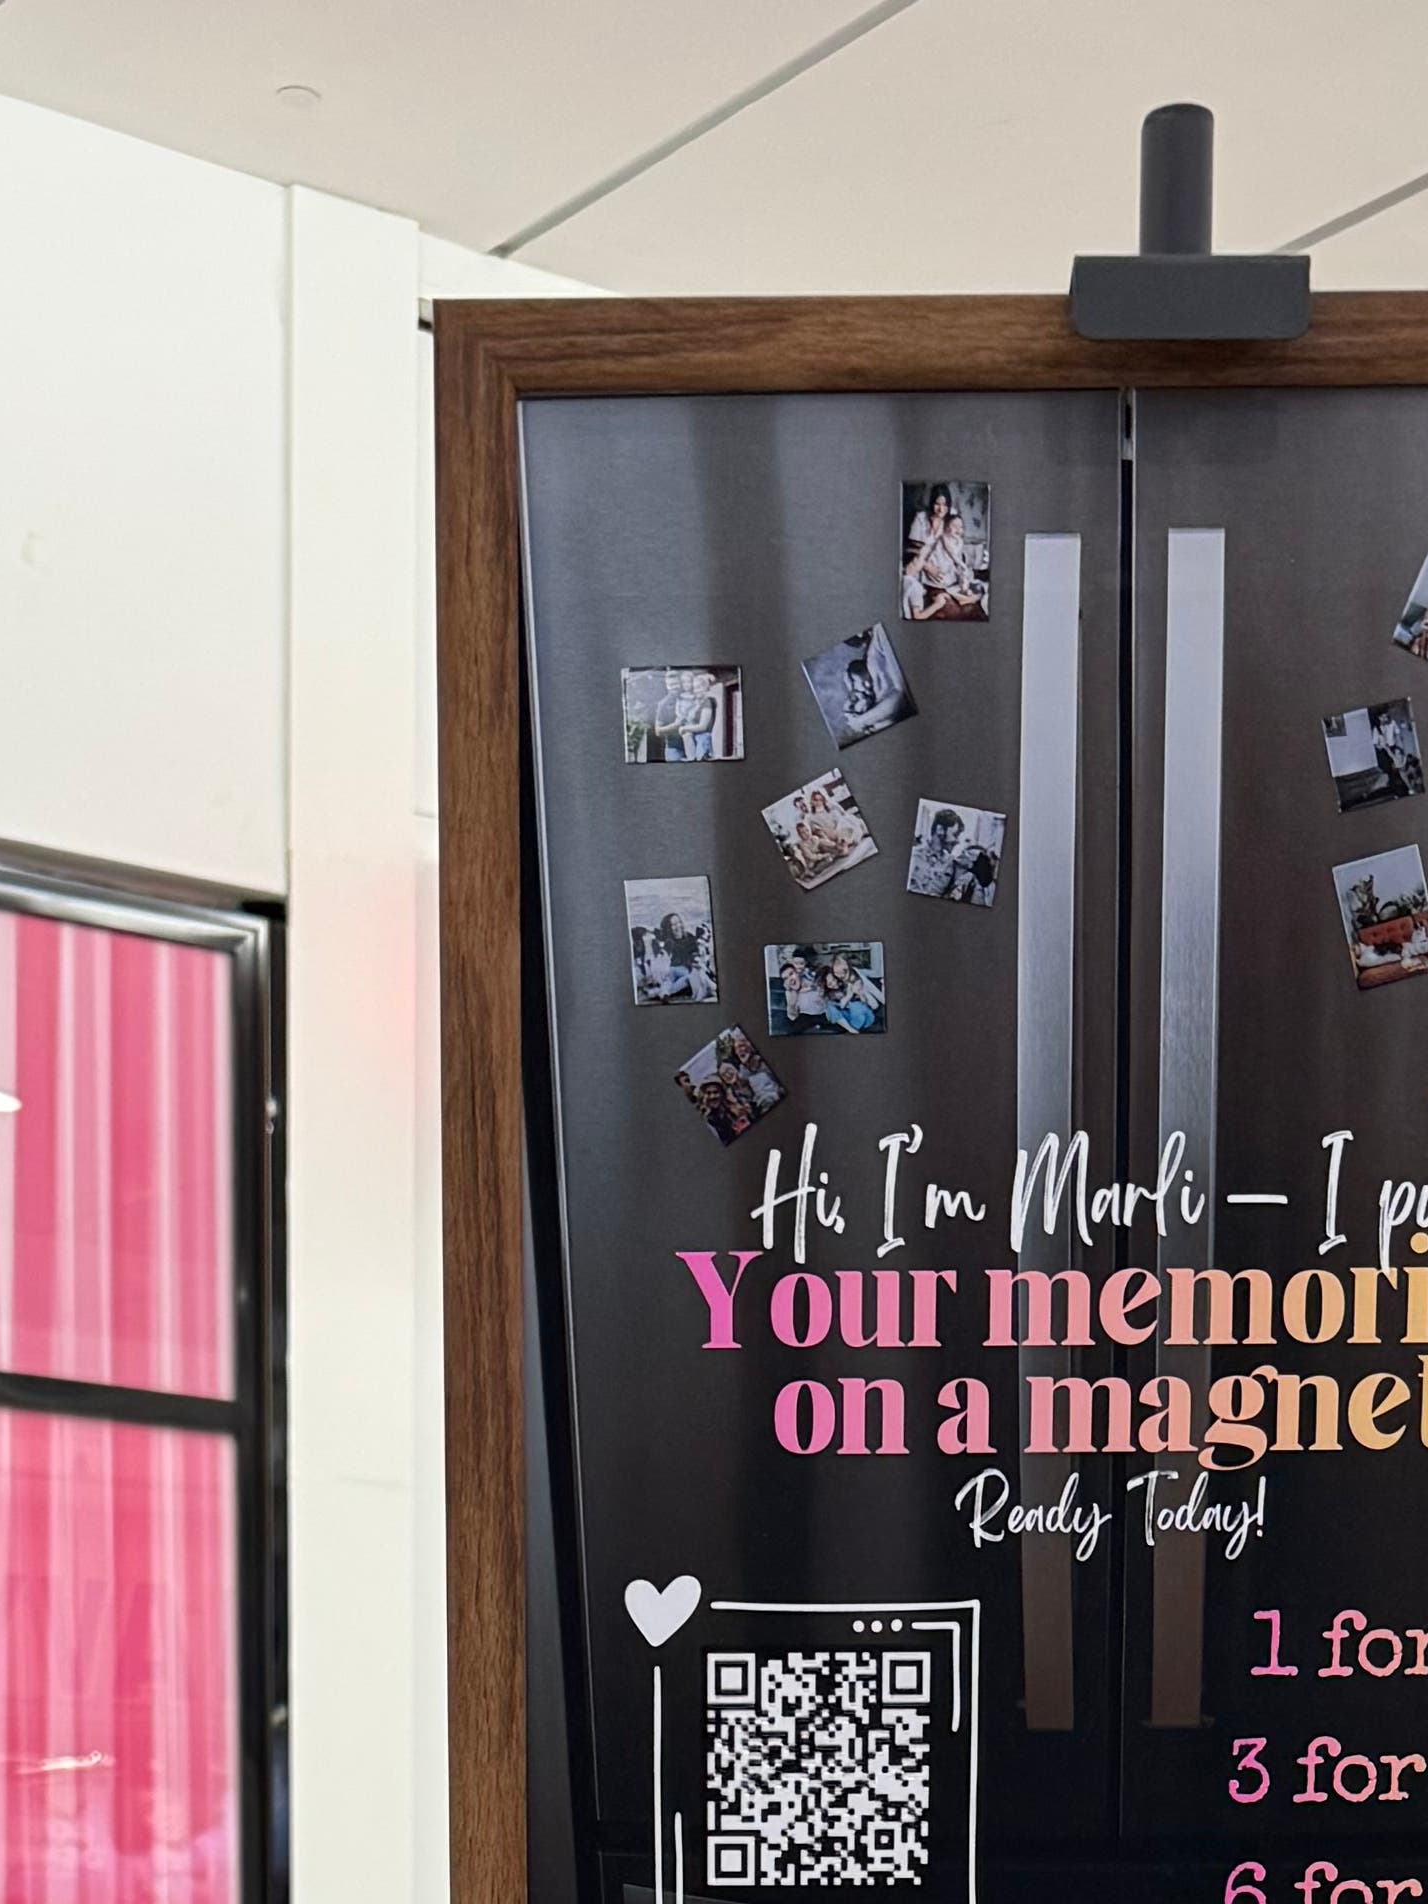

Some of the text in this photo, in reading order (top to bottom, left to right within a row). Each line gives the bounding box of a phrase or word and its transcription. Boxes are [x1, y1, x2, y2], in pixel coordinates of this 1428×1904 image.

[876, 1124, 986, 1258] I'm
[1010, 1130, 1205, 1253] Marli
[1318, 1129, 1354, 1255] I
[675, 1250, 958, 1350] Your
[772, 1376, 910, 1455] on
[936, 1375, 994, 1455] a
[954, 1467, 1267, 1562] Ready Today!
[1250, 1609, 1299, 1677] 1
[1228, 1737, 1270, 1803] 3
[1292, 1736, 1427, 1803] for
